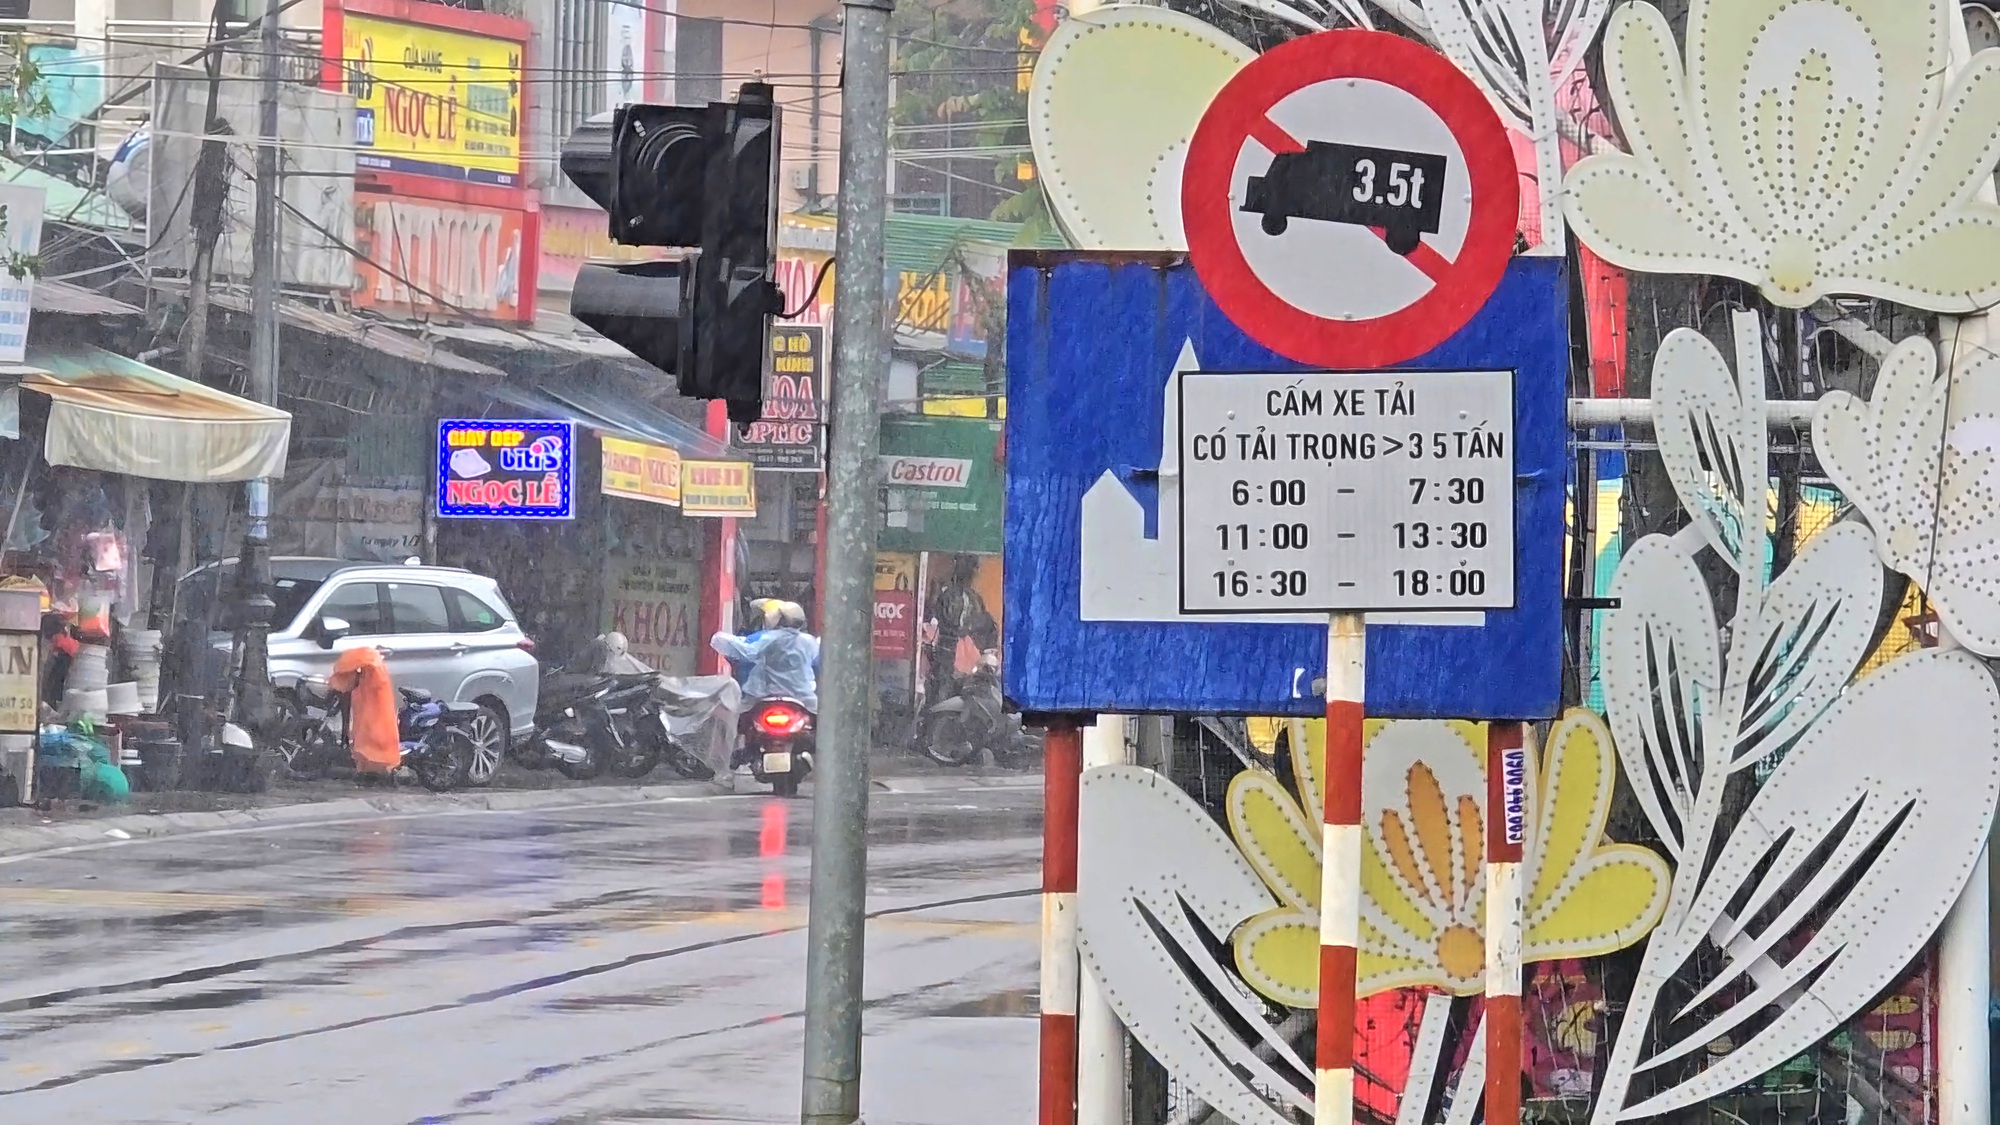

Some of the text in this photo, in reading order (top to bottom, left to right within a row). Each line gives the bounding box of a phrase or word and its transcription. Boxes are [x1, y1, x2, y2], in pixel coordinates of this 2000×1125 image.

[1353, 159, 1424, 209] 3.5t
[1266, 379, 1415, 416] CẤM XE TẢI
[1193, 427, 1226, 460] CÓ
[1236, 426, 1276, 460] TẢI
[1286, 433, 1376, 467] TRỌNG
[1454, 420, 1504, 459] TẤN
[891, 460, 963, 482] Castrol
[447, 479, 523, 509] NGỌC
[1232, 479, 1306, 506] 6:00
[1409, 477, 1485, 504] 7:30
[1216, 523, 1308, 550] 11:00
[1393, 522, 1488, 549] 13:30
[1213, 570, 1307, 597] 16:30
[1393, 569, 1485, 596] 18:00
[613, 600, 691, 647] KHOA
